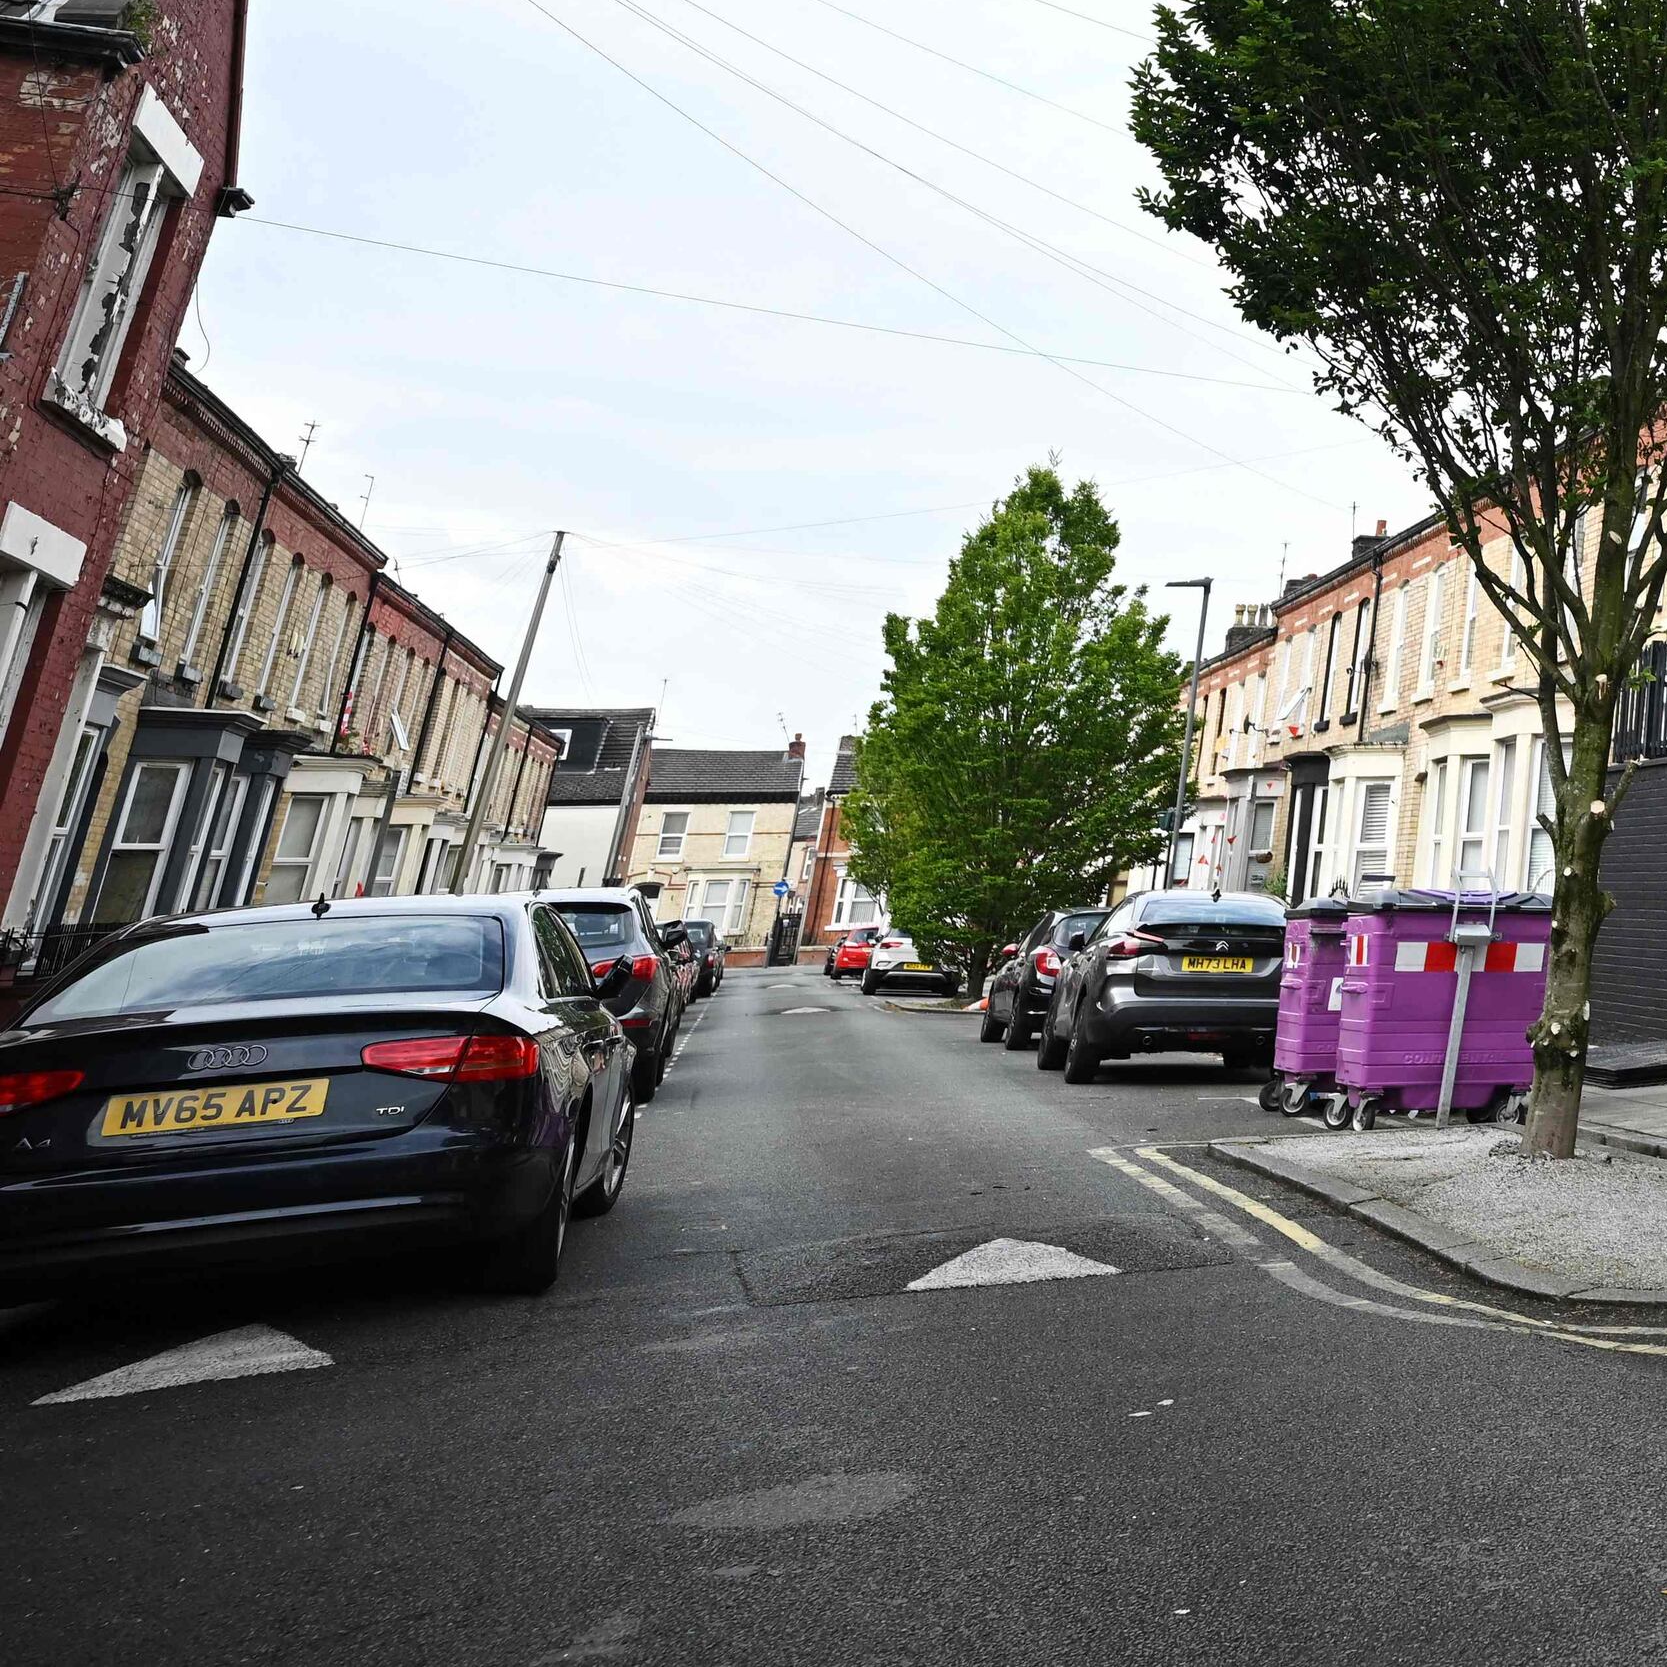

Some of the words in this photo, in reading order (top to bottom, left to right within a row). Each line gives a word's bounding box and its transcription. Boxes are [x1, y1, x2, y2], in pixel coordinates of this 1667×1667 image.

[1187, 957, 1220, 970] MH73
[1222, 957, 1247, 970] LHA
[119, 1092, 228, 1129] MV65
[234, 1084, 312, 1118] APZ
[375, 1106, 405, 1116] TDI
